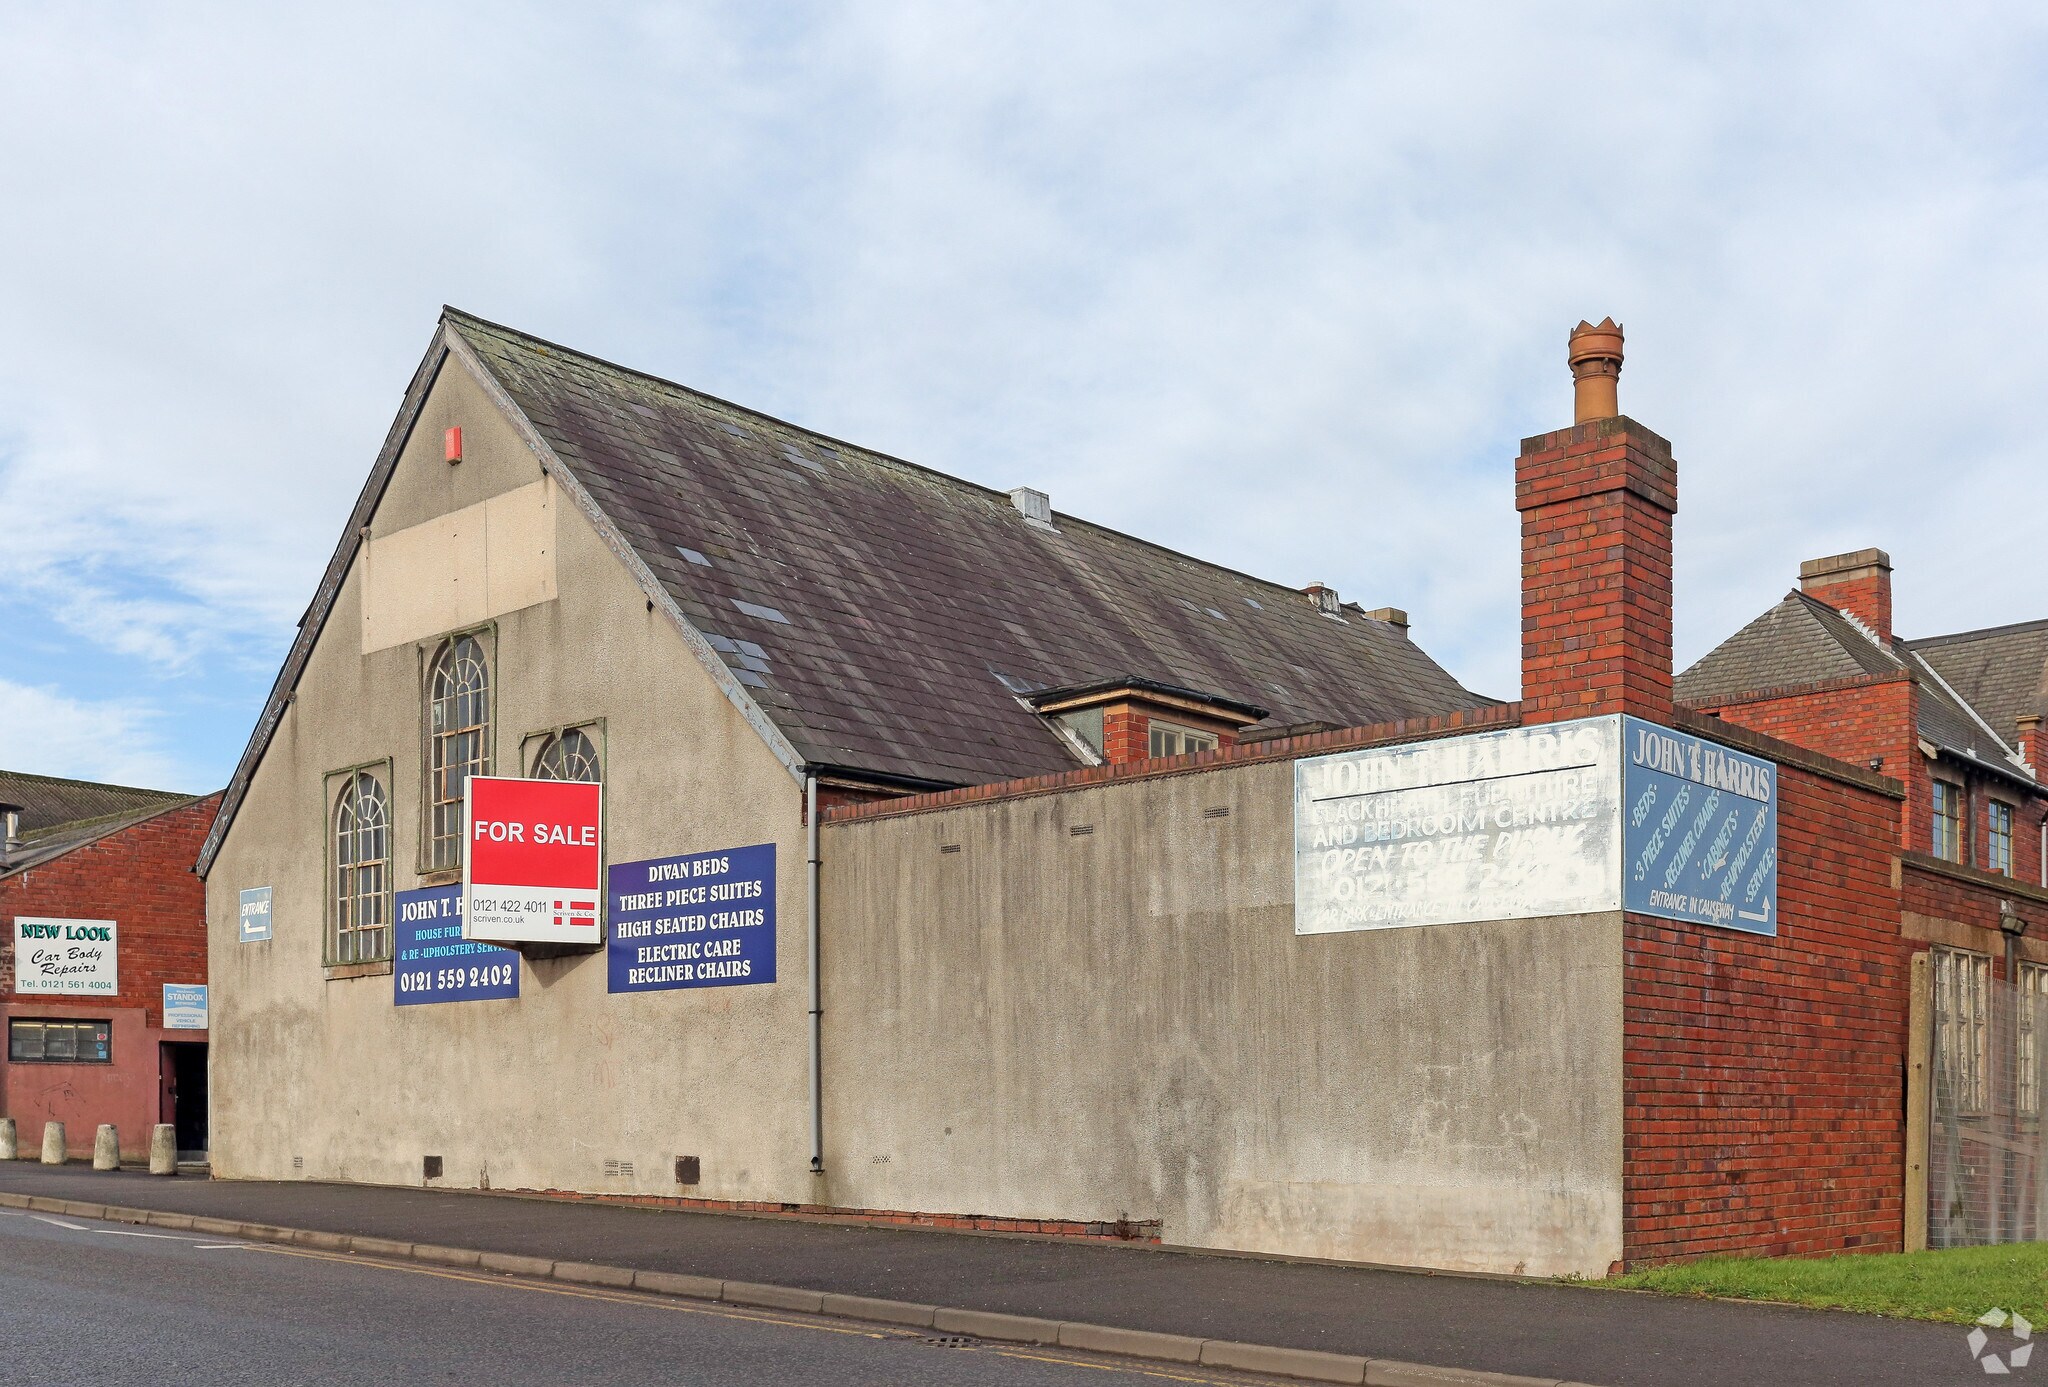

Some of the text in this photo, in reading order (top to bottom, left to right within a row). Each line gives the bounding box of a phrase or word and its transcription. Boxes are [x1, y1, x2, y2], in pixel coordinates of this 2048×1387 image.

[1313, 755, 1402, 797] JOHN
[1443, 727, 1599, 780] HARIS
[1633, 729, 1685, 776] JOHN
[1704, 750, 1770, 802] HARRIS
[1633, 784, 1656, 828] BEDS
[475, 821, 596, 846] FOR SALE
[1313, 801, 1597, 848] AND BEDROOM CENTRE
[1636, 785, 1690, 881] 3 PIECE SUITES
[1665, 789, 1719, 888] RECLINER CHAIRS
[1703, 811, 1737, 879] CABINETS
[1321, 843, 1394, 874] OPEN
[1401, 840, 1433, 867] TO
[1440, 834, 1489, 864] THE
[649, 857, 729, 882] DIVAN BEDS
[1747, 848, 1773, 903] SERVICE
[473, 899, 497, 911] 0121
[501, 900, 520, 912] 422
[524, 901, 547, 913] 4011
[620, 880, 762, 911] THREE PIECE SUITES
[1650, 890, 1734, 920] ENTRANCE IN CAUSEWAY
[241, 900, 269, 917] ENTRANCE
[401, 900, 437, 922] JOHN
[441, 898, 451, 917] T.
[473, 914, 525, 924] scriven.co.uk
[21, 924, 112, 941] NEW LOOK
[415, 928, 442, 940] HOUSE
[617, 909, 764, 938] HIGH SEATED CHAIRS
[31, 947, 102, 964] Car Body
[401, 950, 408, 960] &
[637, 939, 741, 963] ELECTRIC CARE
[40, 963, 97, 977] Repairs
[401, 965, 512, 992] 0121 559 2402
[628, 960, 751, 984] RECLINER CHAIRS
[21, 980, 38, 988] Tel.
[41, 980, 64, 988] 0121
[167, 992, 204, 1002] STANDOX
